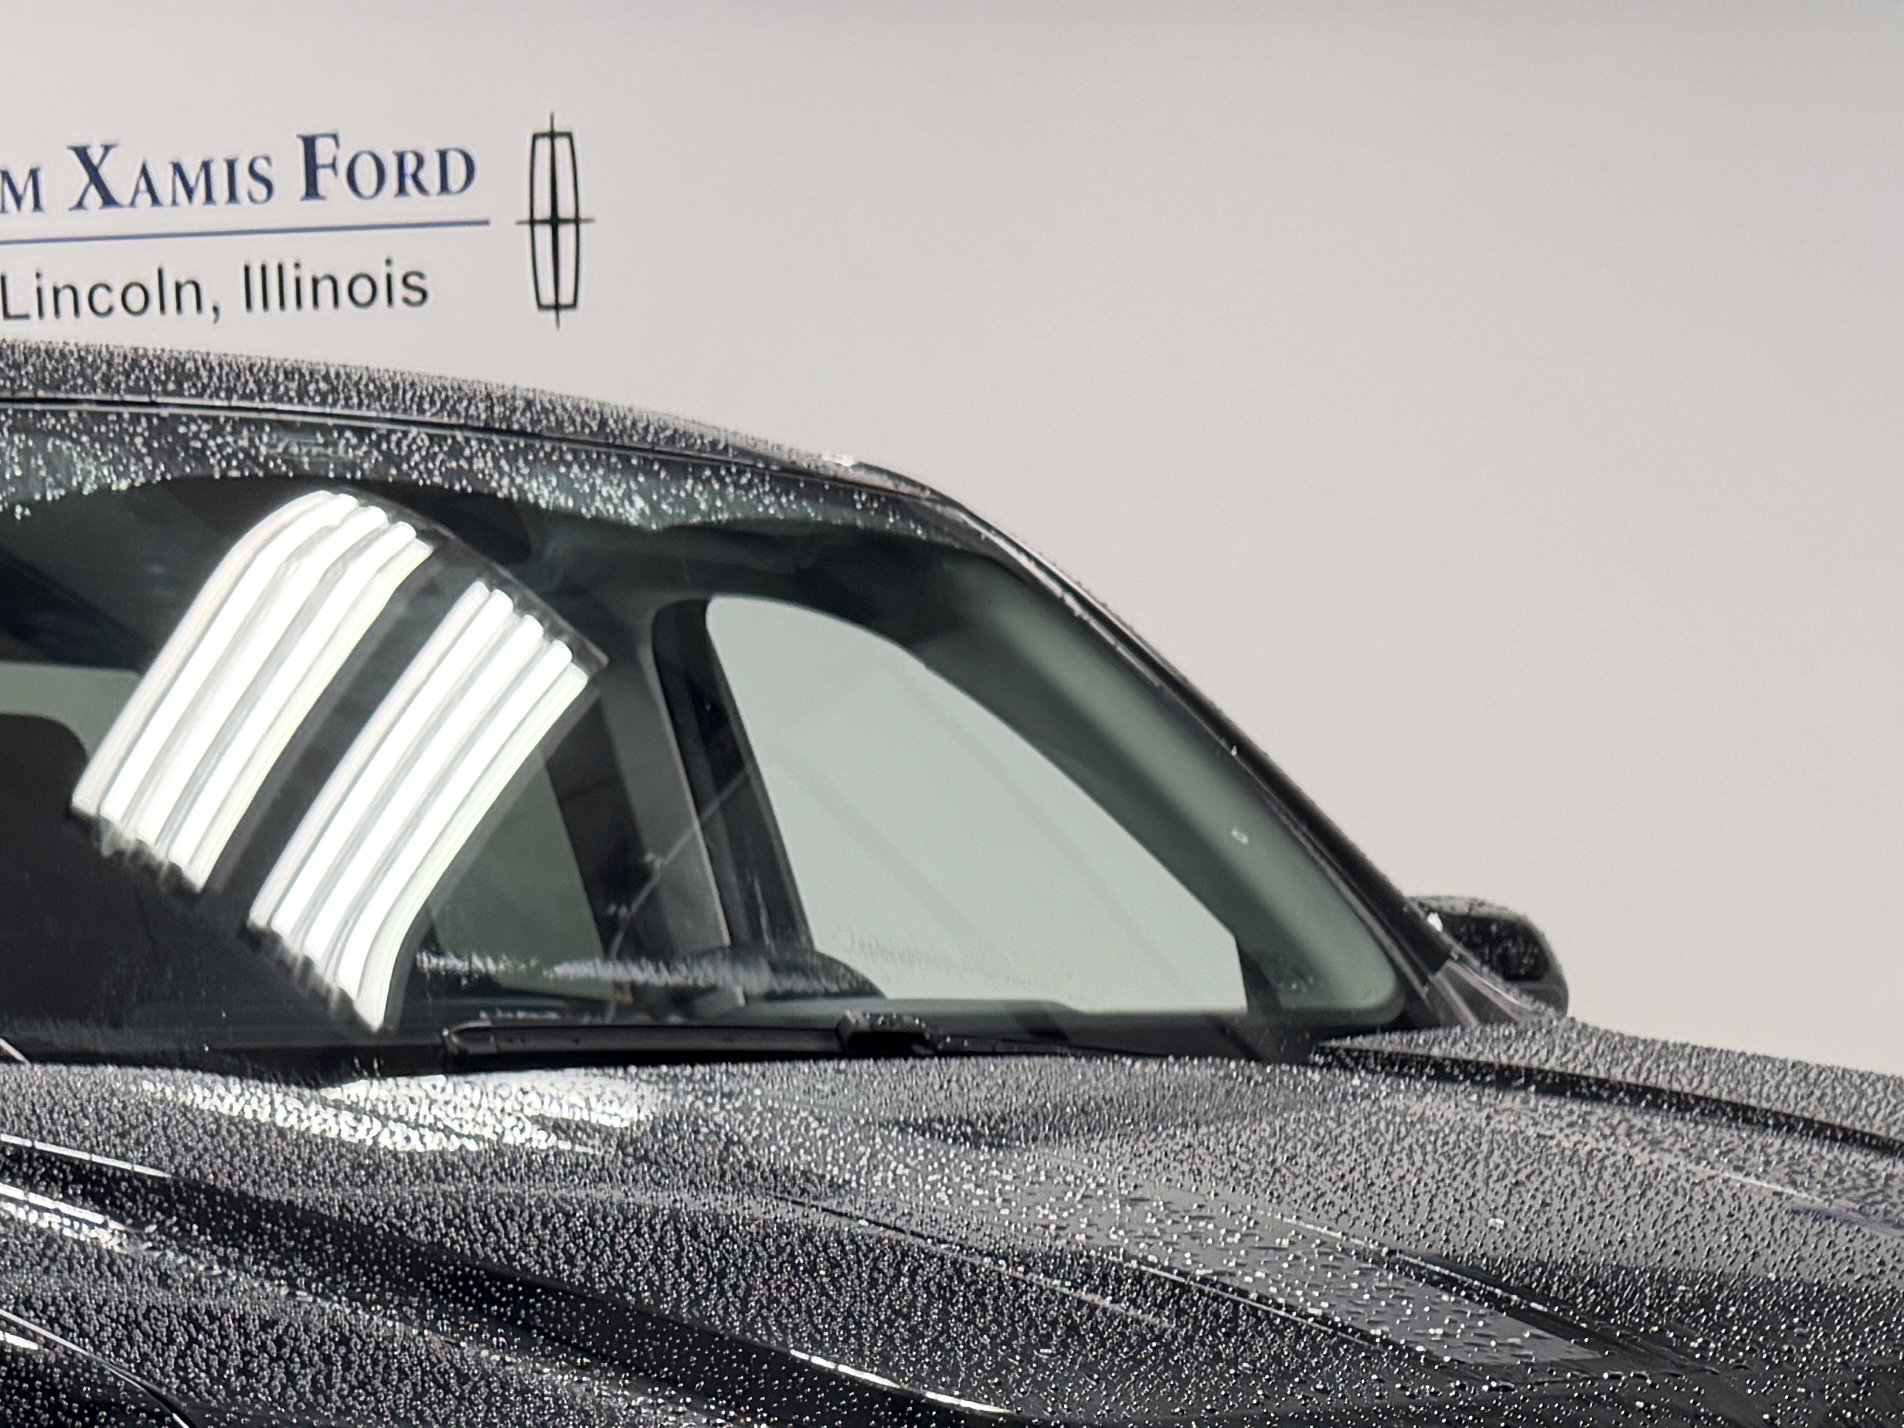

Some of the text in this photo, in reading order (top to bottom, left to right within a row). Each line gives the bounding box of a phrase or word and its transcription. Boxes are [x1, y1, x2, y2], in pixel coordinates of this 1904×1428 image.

[66, 142, 275, 212] XAMIS
[296, 132, 476, 201] FORD
[0, 256, 429, 324] Lincoln, Illinois
